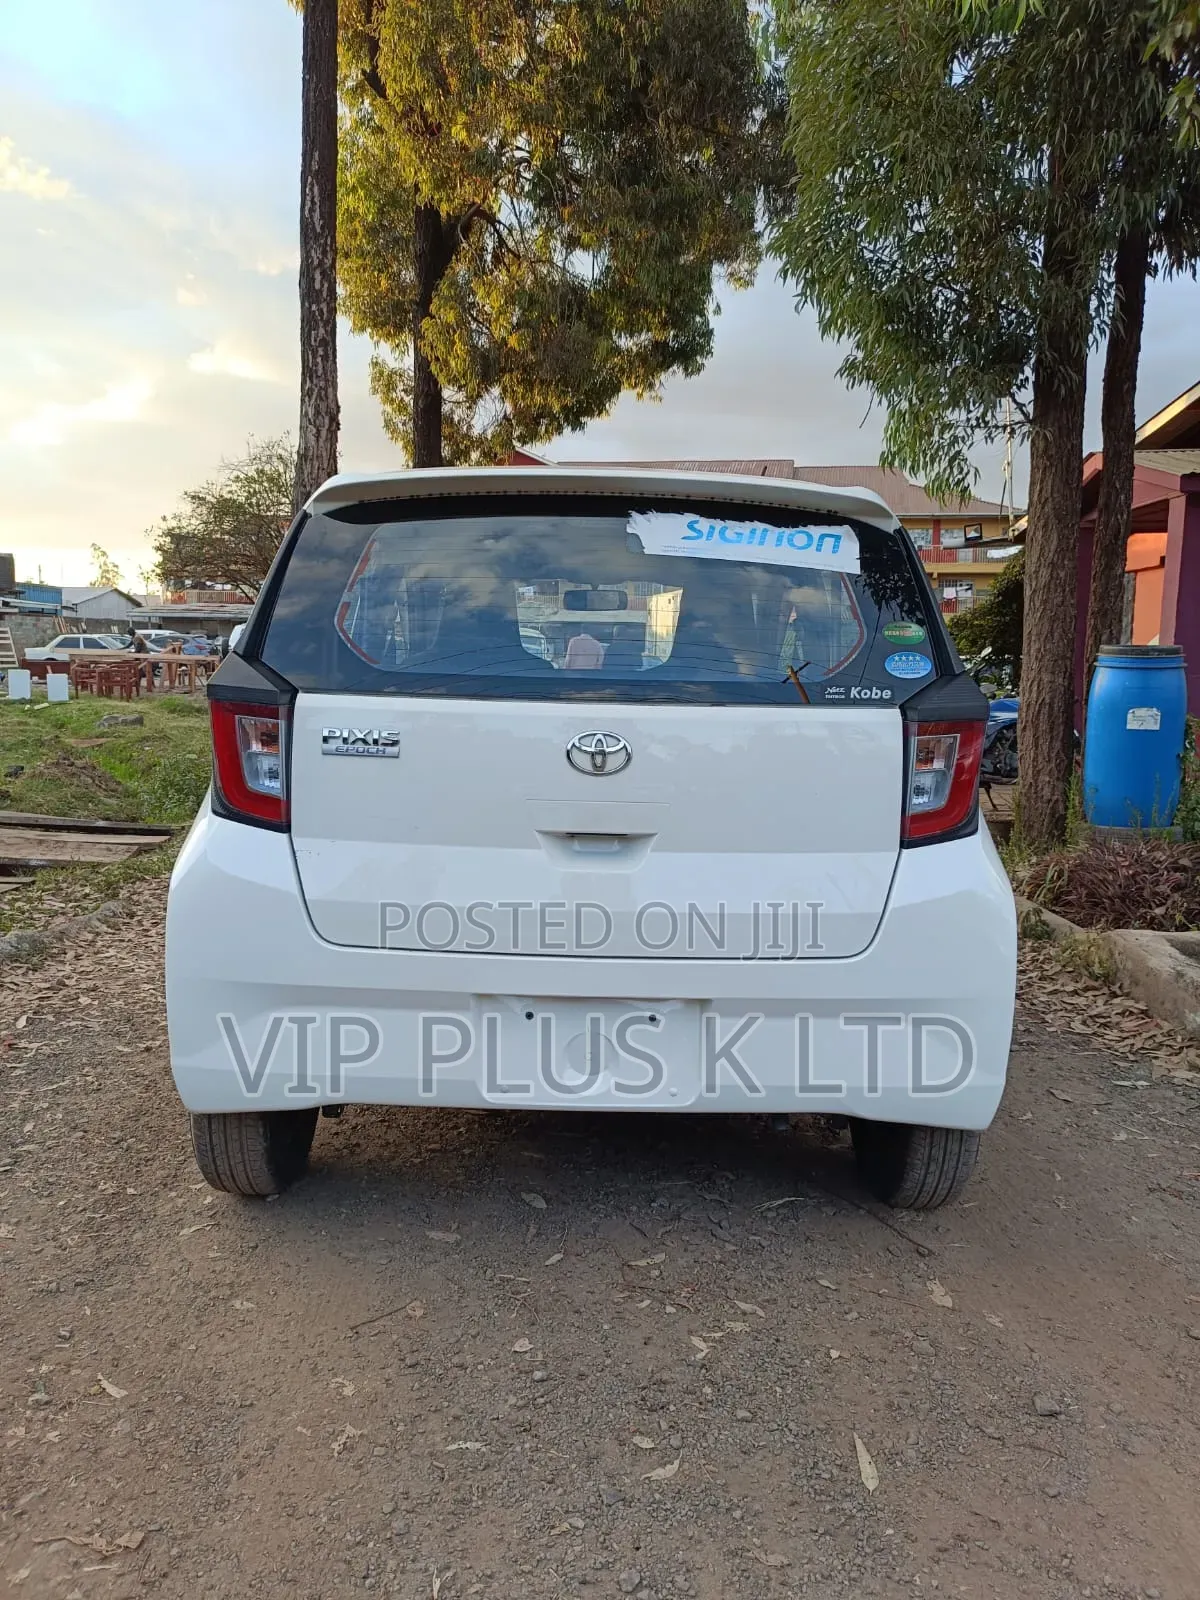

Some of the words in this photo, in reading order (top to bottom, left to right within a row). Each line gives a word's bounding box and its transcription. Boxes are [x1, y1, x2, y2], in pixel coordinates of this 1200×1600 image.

[850, 686, 892, 700] Kobe
[322, 727, 401, 747] PIXIS
[335, 745, 387, 755] EPOCH
